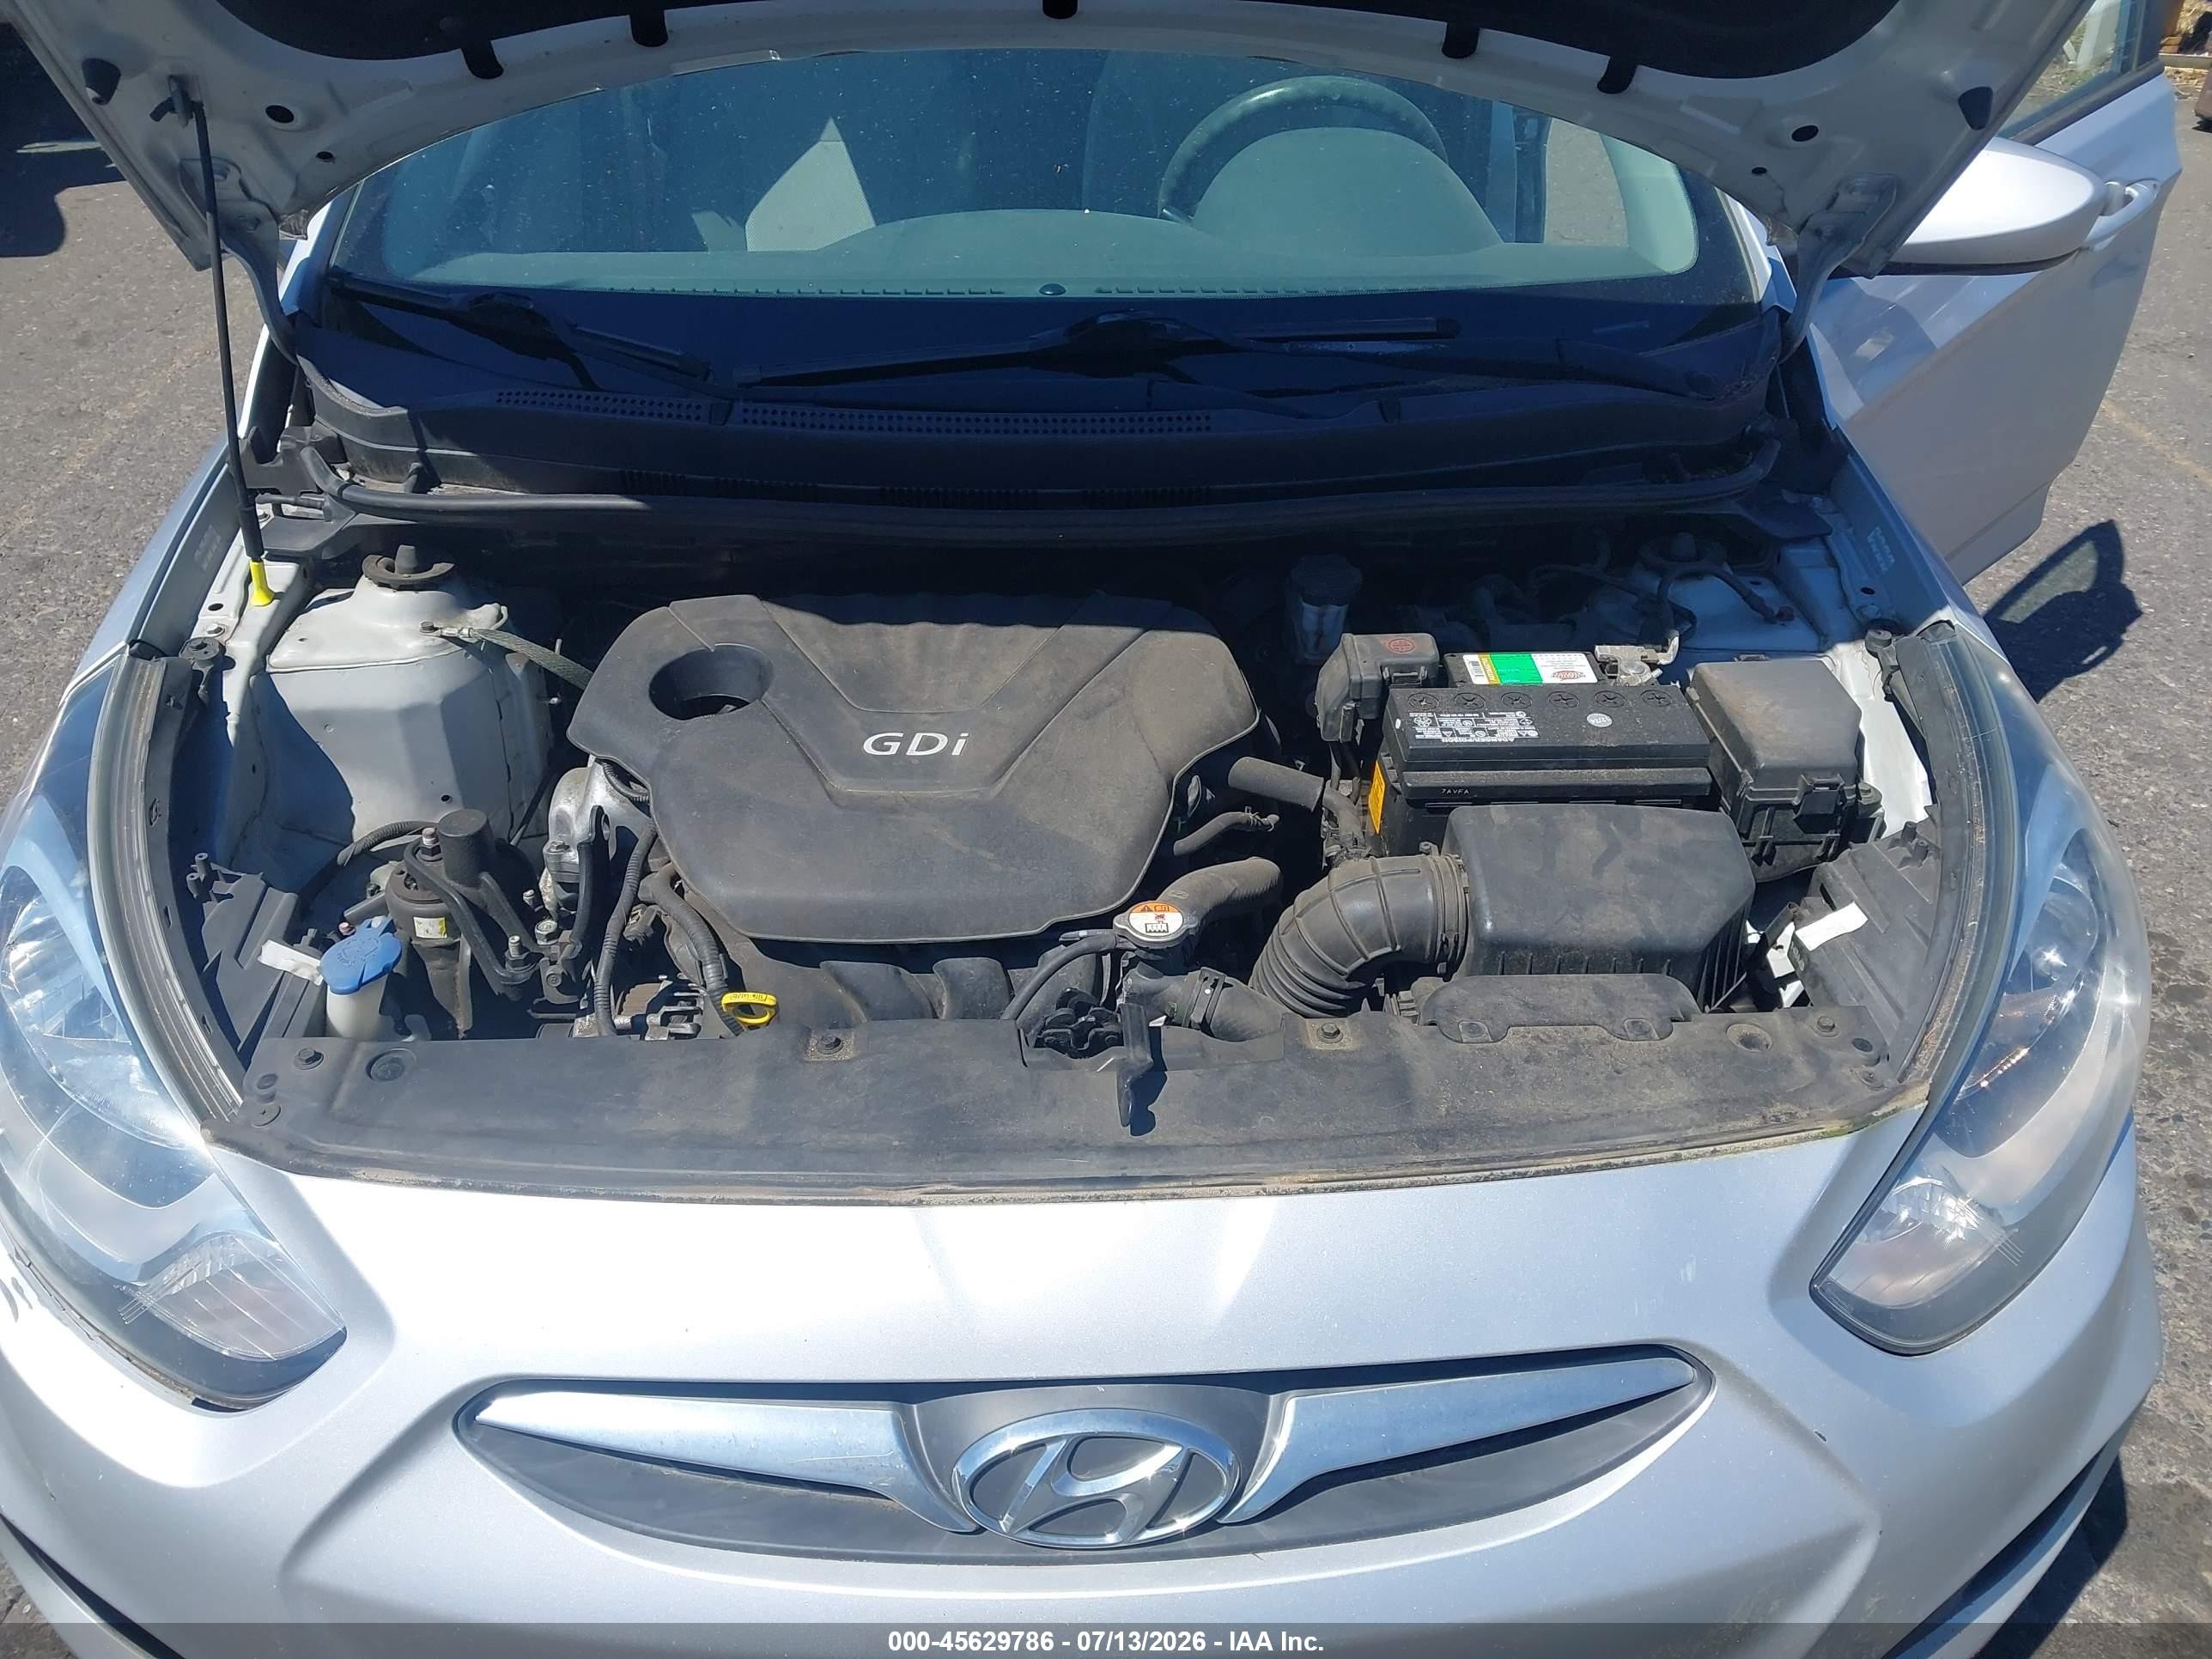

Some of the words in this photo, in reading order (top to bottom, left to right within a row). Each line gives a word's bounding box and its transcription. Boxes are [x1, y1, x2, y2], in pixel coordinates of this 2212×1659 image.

[862, 732, 970, 757] GDi
[730, 993, 750, 1001] ENG
[751, 994, 765, 1002] OIL
